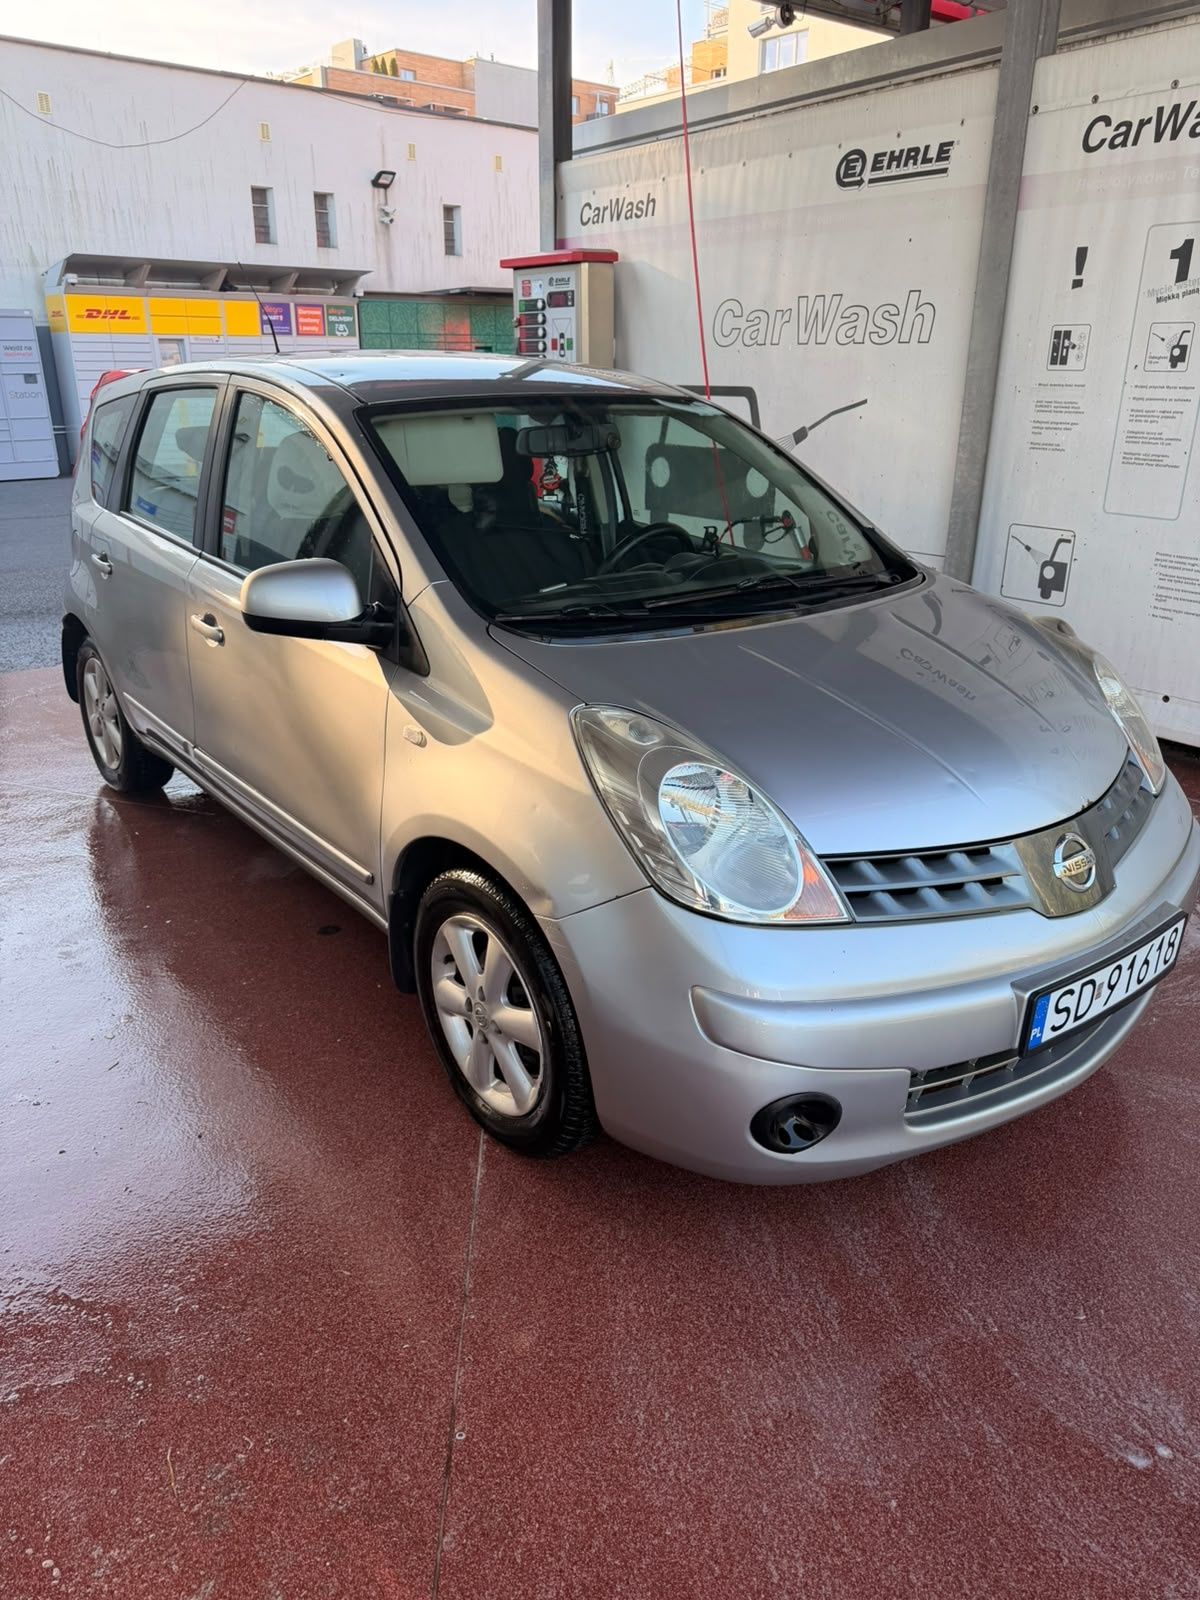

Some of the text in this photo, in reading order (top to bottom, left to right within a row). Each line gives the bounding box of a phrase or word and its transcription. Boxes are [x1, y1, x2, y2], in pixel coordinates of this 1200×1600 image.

[870, 140, 955, 173] EHRLE
[580, 192, 656, 227] CarWash
[1170, 238, 1195, 284] 1
[84, 308, 132, 321] DHL
[713, 289, 936, 347] CarWash
[1050, 926, 1180, 1033] SD 91618
[1030, 1026, 1042, 1041] PL
